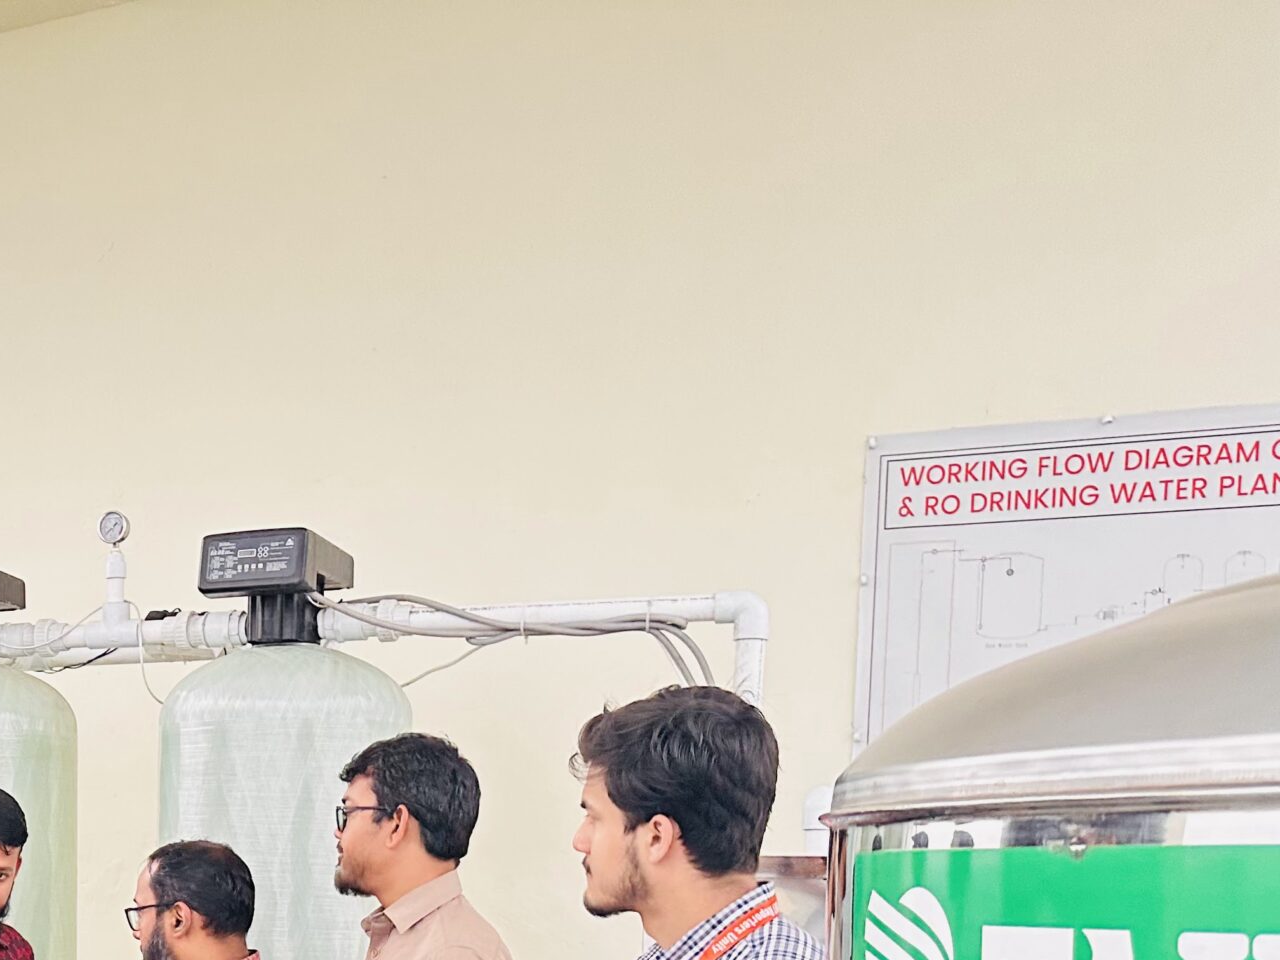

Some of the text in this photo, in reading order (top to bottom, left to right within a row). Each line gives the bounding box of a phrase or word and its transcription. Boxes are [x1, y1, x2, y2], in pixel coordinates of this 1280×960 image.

[900, 458, 1028, 487] WORKING
[1038, 451, 1114, 477] FLOW
[1124, 440, 1260, 471] DIAGRAM
[898, 496, 915, 518] &
[924, 494, 961, 516] RO
[970, 485, 1100, 513] DRINKING
[1110, 478, 1208, 504] WATER
